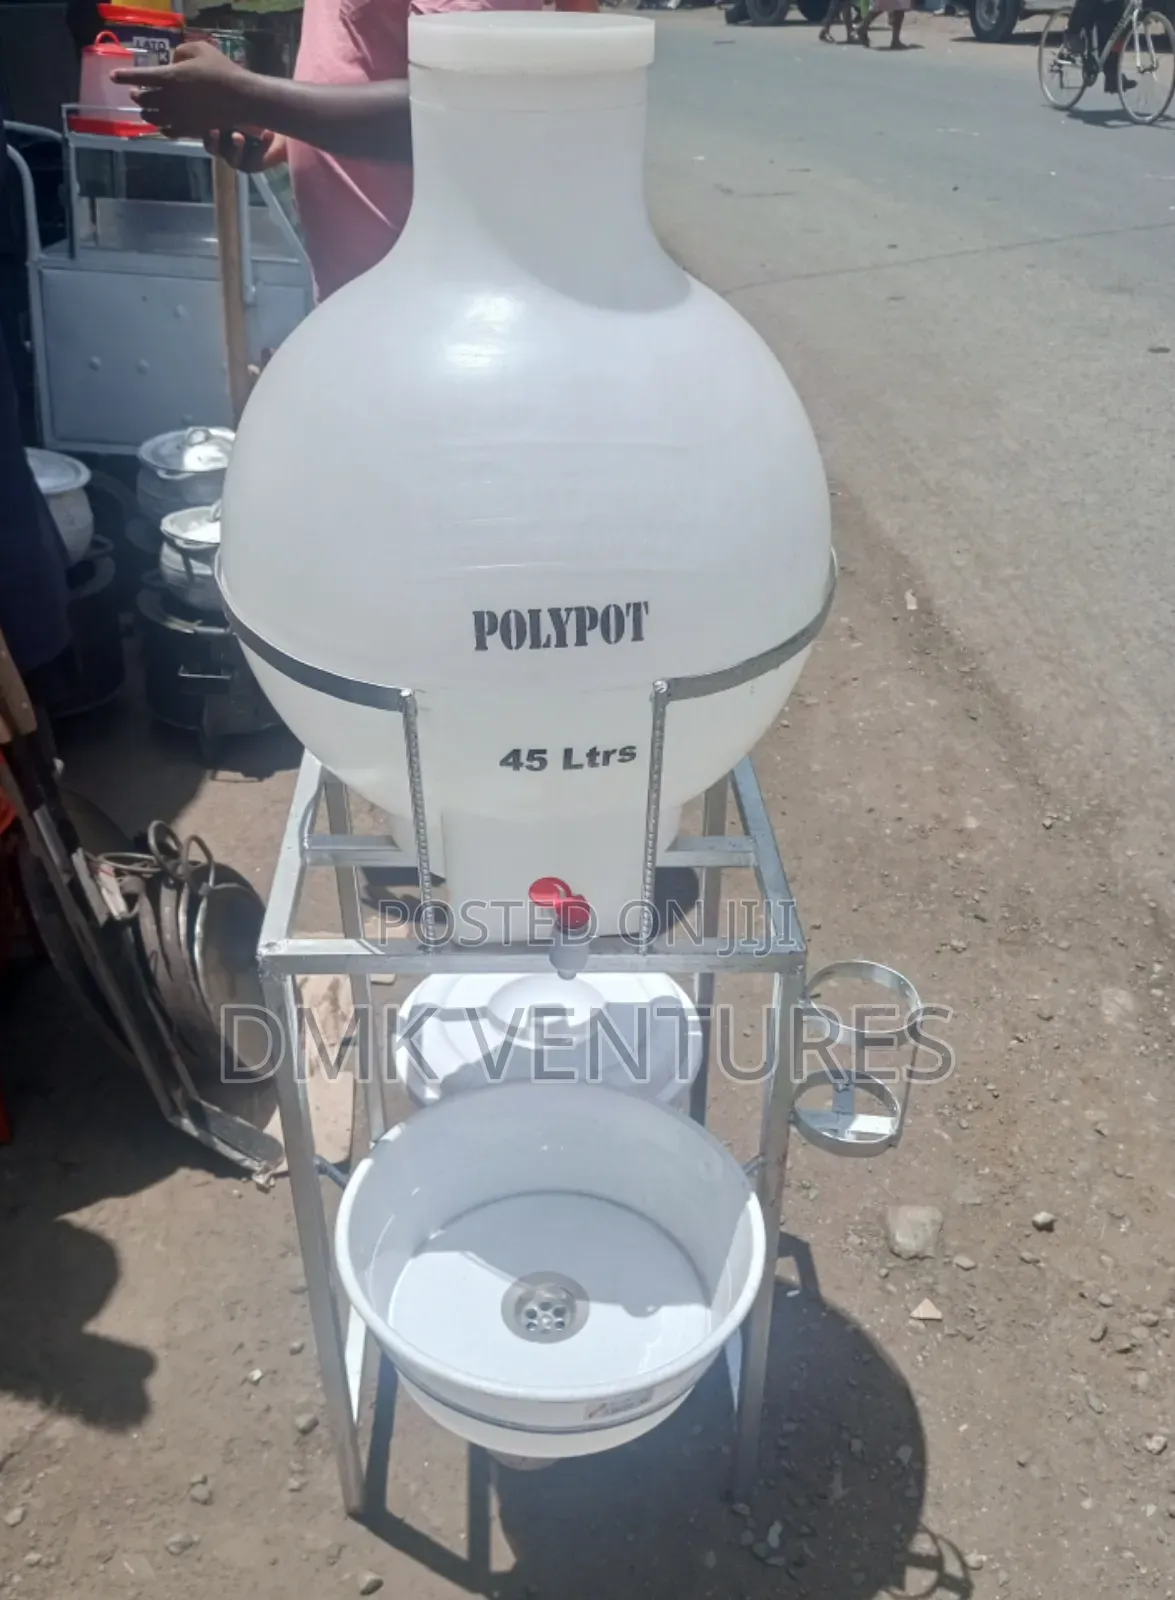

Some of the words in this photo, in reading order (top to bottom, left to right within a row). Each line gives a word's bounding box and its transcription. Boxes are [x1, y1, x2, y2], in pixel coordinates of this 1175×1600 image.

[472, 601, 649, 651] POLYPOT
[499, 748, 548, 772] 45
[562, 745, 637, 770] Ltrs
